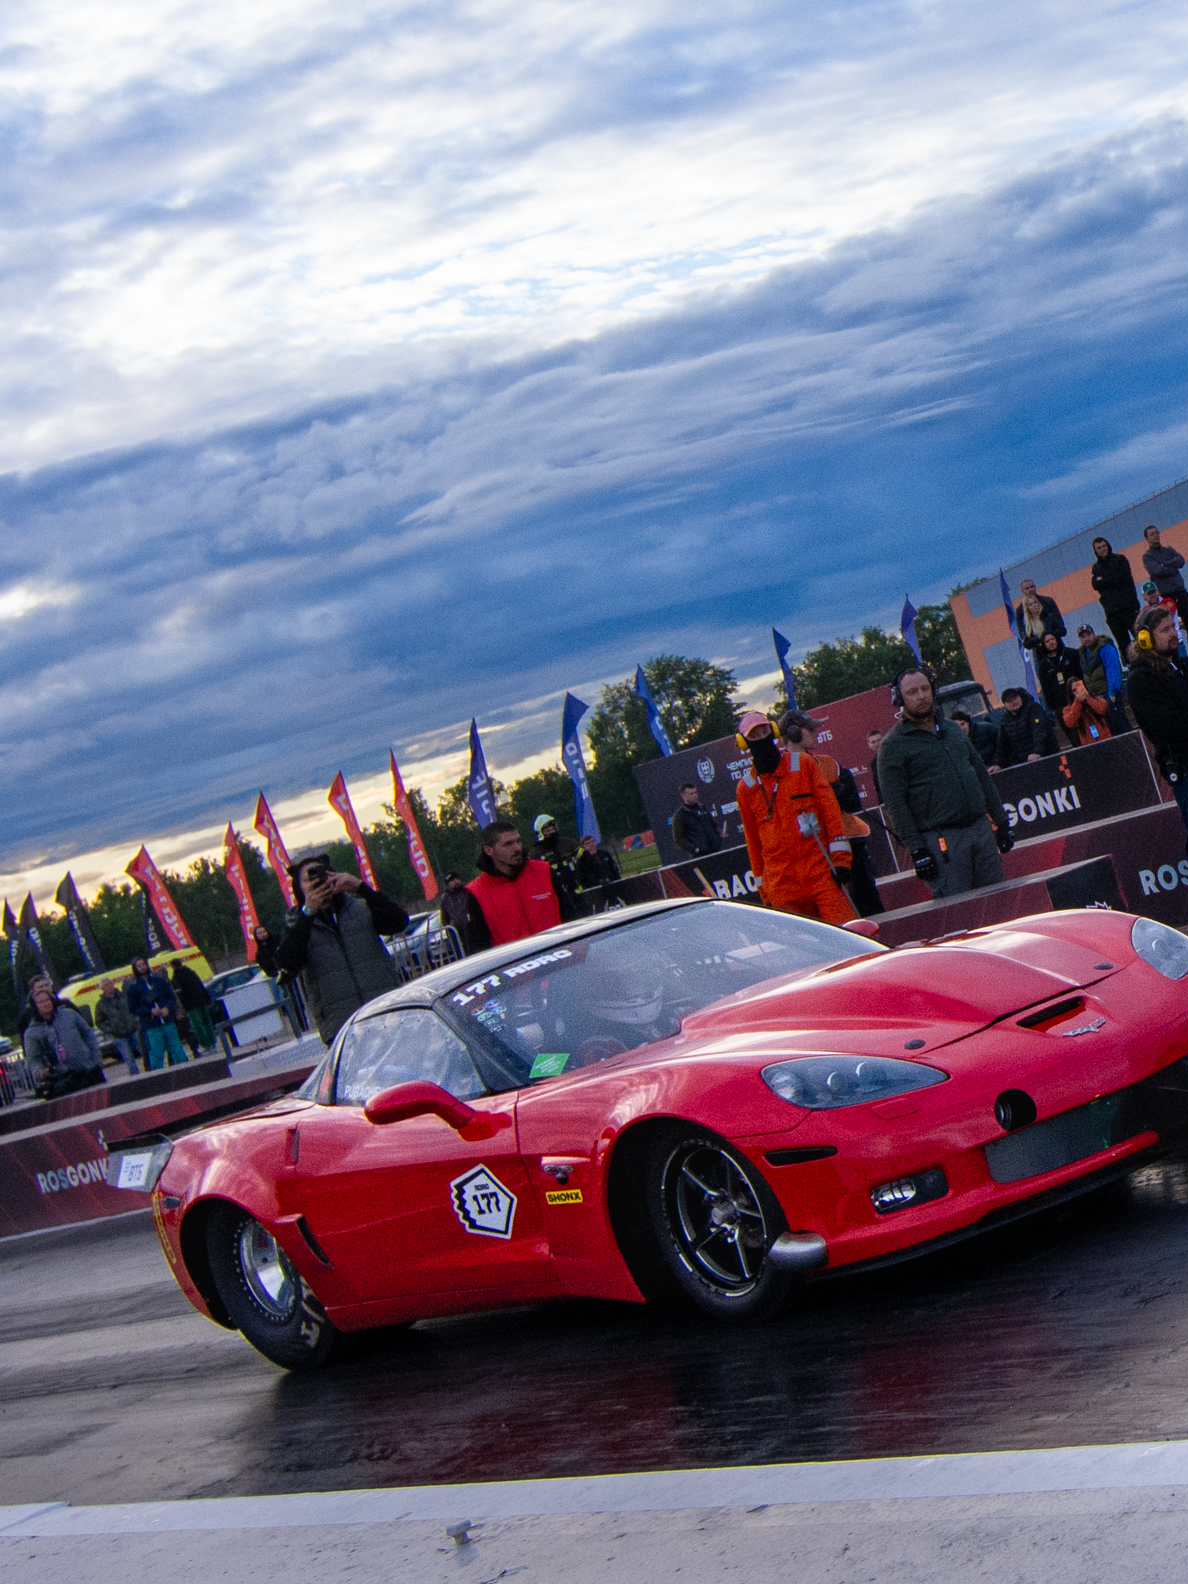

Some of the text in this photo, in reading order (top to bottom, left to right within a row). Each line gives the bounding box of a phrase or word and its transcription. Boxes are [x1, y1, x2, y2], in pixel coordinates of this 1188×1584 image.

[1002, 785, 1081, 827] GONKI
[714, 871, 756, 899] RAC
[453, 975, 501, 1006] 177
[37, 1157, 109, 1194] ROSGONK
[472, 1192, 501, 1215] 177
[547, 1192, 582, 1203] SHONX
